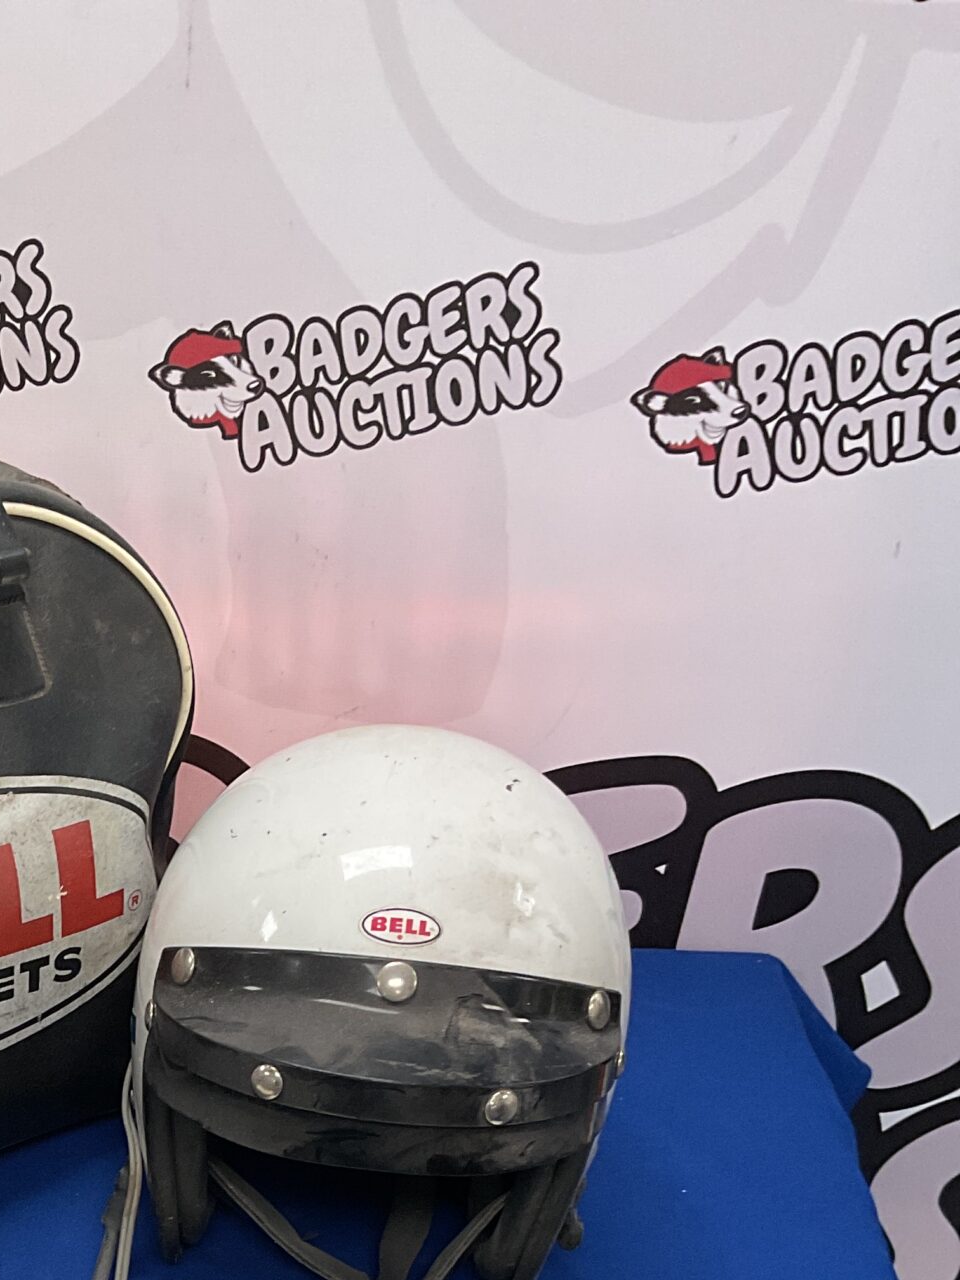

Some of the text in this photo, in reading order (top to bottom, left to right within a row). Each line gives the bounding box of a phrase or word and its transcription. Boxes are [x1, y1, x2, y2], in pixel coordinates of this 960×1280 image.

[242, 261, 541, 399] BADGERS
[238, 328, 562, 473] AUCTIONS
[371, 916, 431, 937] BELL
